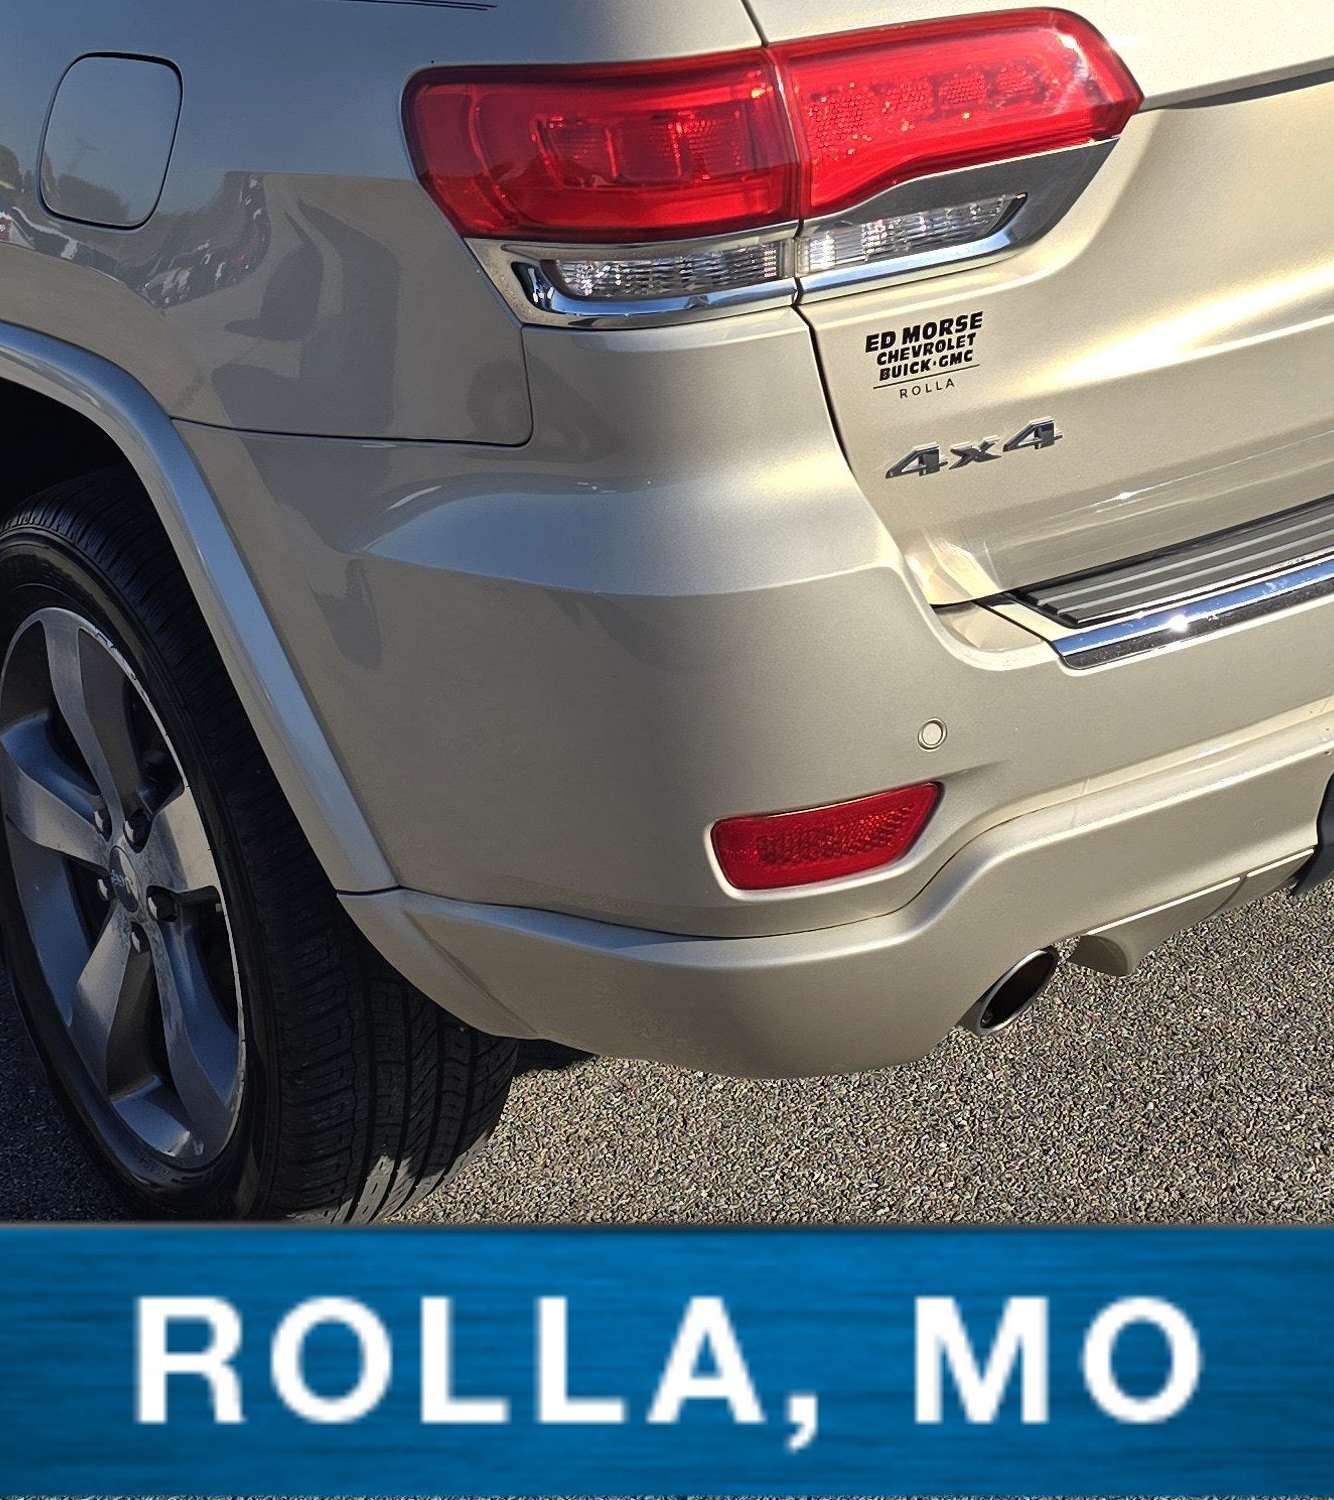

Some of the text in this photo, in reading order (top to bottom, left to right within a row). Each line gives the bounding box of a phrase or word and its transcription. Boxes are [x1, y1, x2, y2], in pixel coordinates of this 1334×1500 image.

[865, 310, 984, 353] ED MORSE
[876, 332, 977, 366] CHEVROLET
[899, 377, 955, 400] ROLLA
